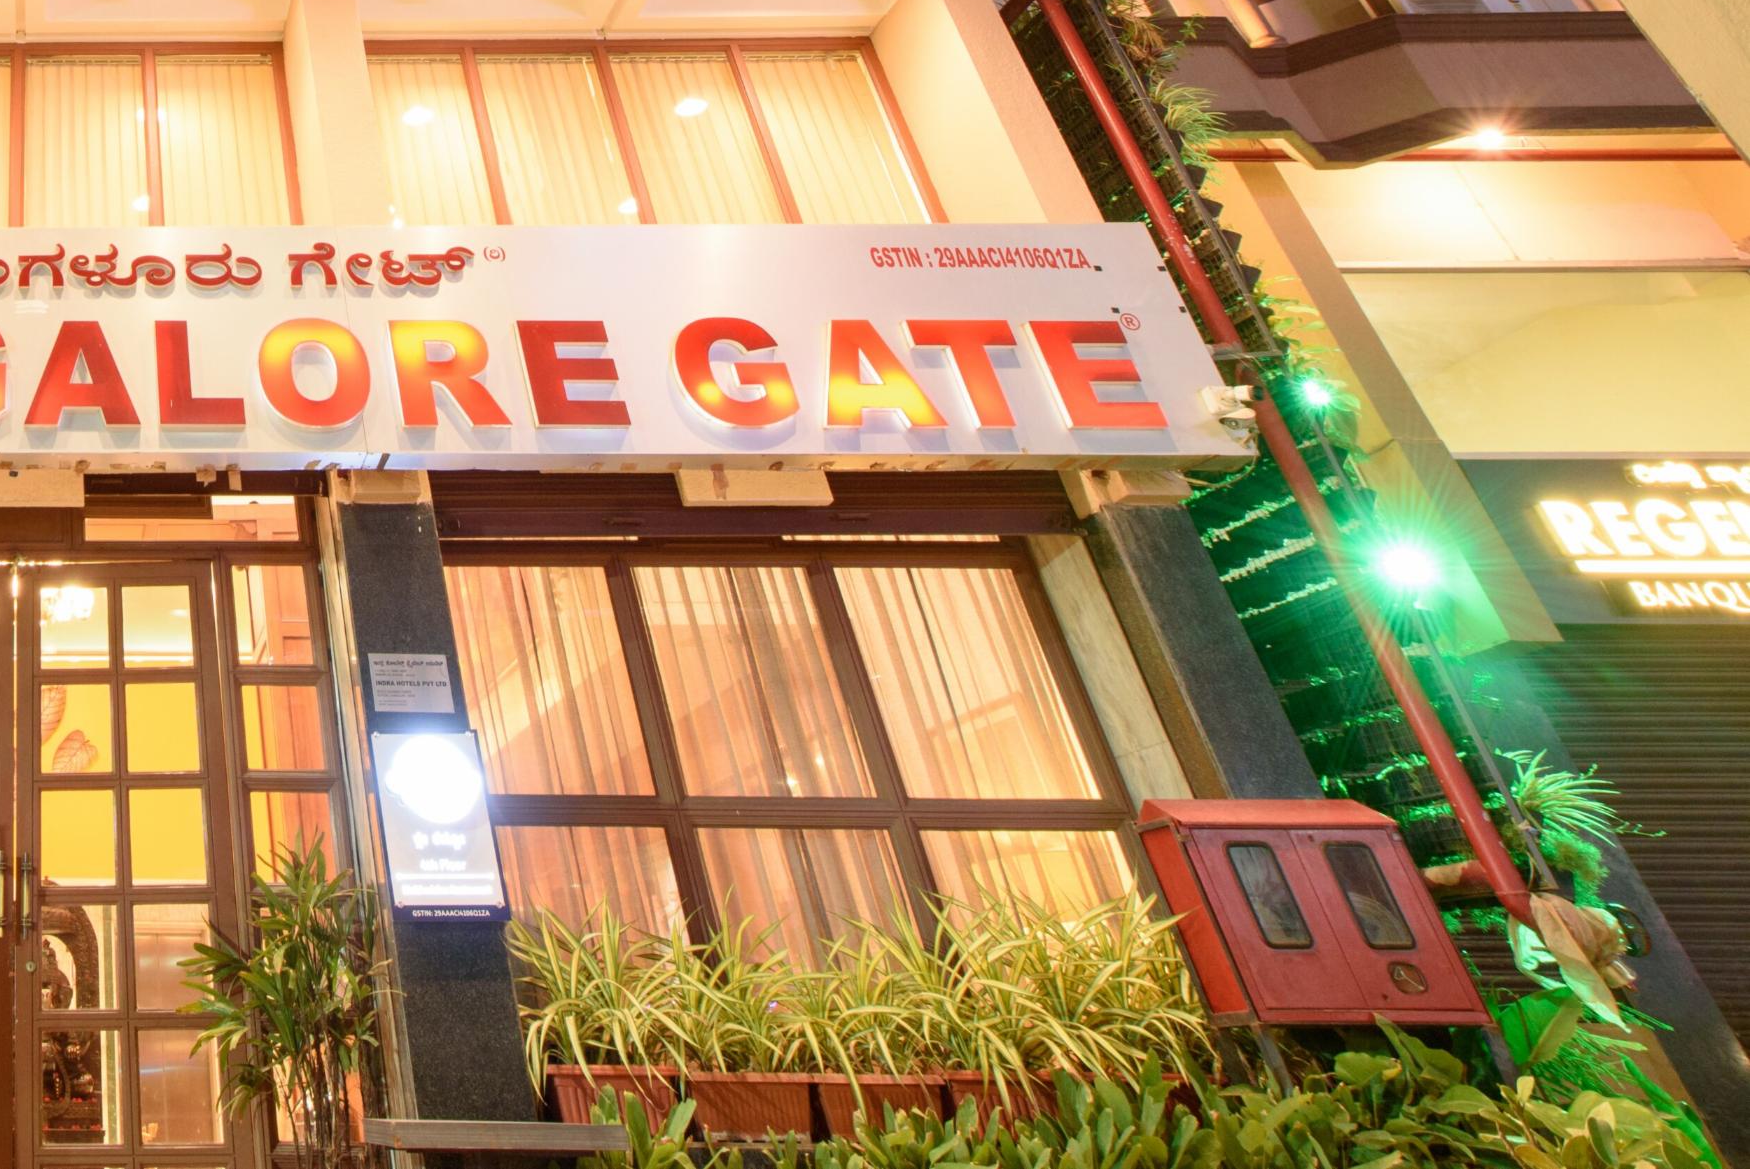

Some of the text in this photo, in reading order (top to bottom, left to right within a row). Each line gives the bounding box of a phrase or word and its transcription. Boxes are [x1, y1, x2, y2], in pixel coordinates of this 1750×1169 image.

[287, 242, 475, 289] ಗೇಟ್
[869, 246, 923, 269] GSTIN
[934, 246, 1092, 270] 29AAACI4106Q1ZA
[672, 316, 1170, 430] GATE
